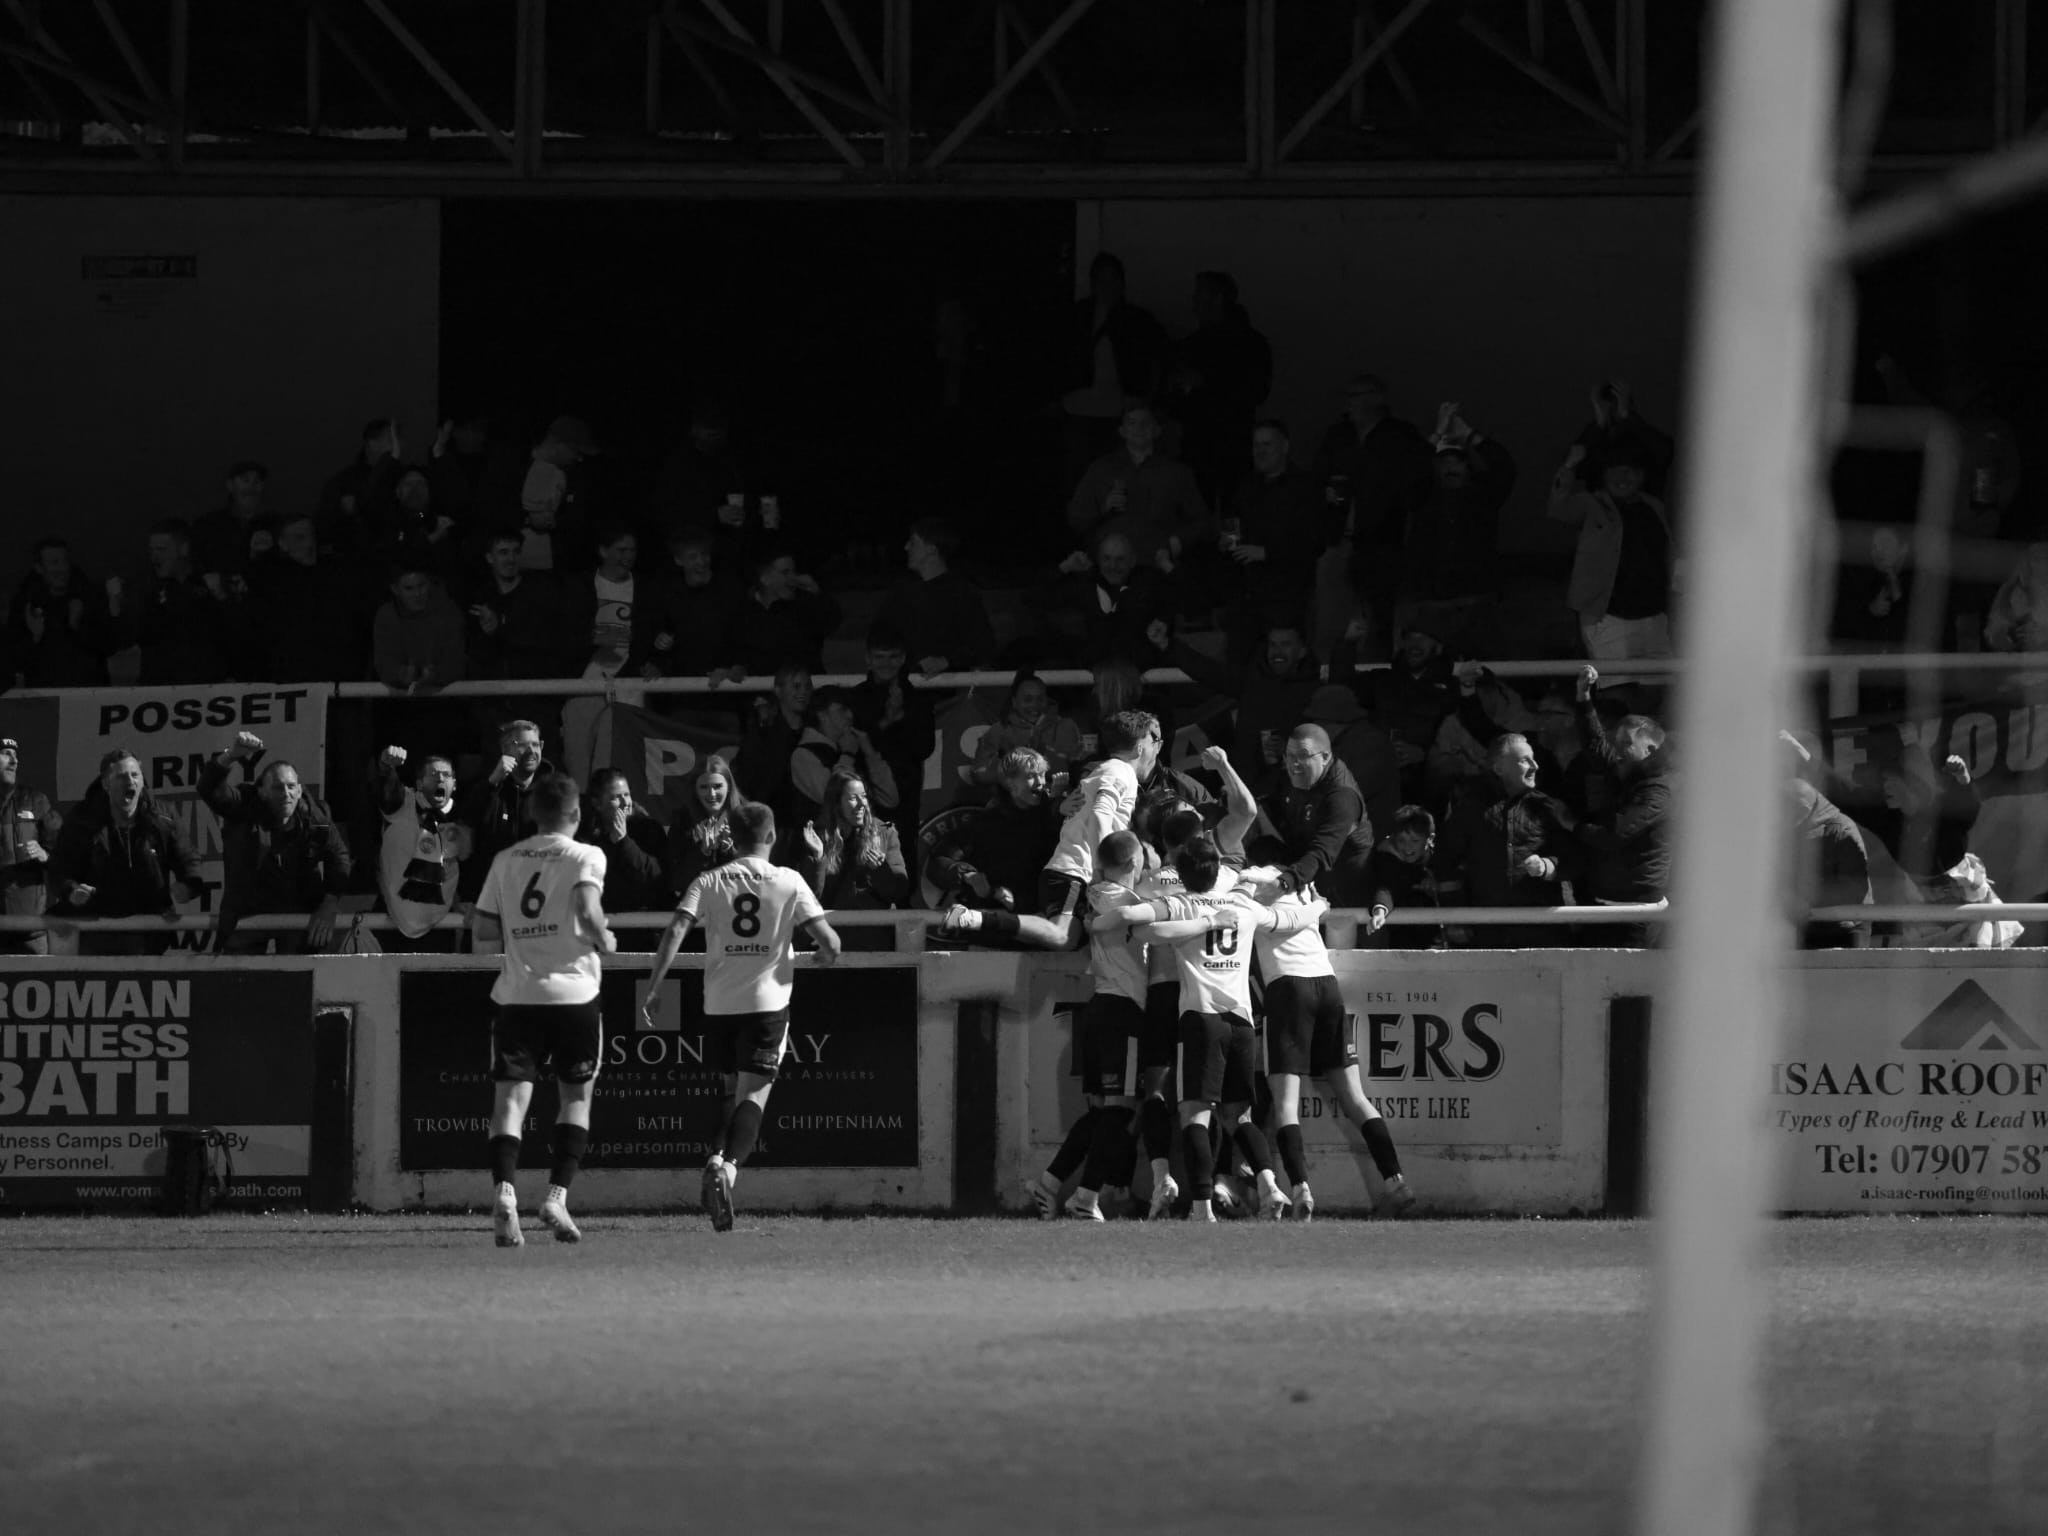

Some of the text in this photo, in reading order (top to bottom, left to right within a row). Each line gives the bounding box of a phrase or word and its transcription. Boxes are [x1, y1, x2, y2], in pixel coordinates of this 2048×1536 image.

[99, 689, 307, 736] POSSET
[152, 748, 266, 789] RMY
[1160, 876, 1184, 885] mac
[521, 871, 546, 919] 6
[732, 893, 760, 938] 8
[511, 923, 559, 936] carite
[1206, 926, 1239, 956] 10
[725, 943, 770, 953] carite
[1203, 960, 1241, 969] carite
[0, 979, 191, 1019] OMAN
[1407, 992, 1438, 1002] 1904
[0, 1023, 190, 1058] ITNESS
[1770, 1062, 2048, 1096] ISAAC ROOF
[594, 1087, 718, 1098] Originated 1841
[1367, 1096, 1420, 1119] ASTE
[1427, 1096, 1471, 1119] LIKE
[637, 1116, 684, 1131] BATH
[778, 1114, 905, 1129] CHIPPENHAM
[1777, 1110, 1832, 1133] Types
[1838, 1110, 1862, 1133] of
[1864, 1110, 1944, 1133] Roofing
[1951, 1110, 1968, 1128] &
[1975, 1110, 2026, 1128] Lead
[57, 1133, 123, 1152] Camps
[225, 1132, 249, 1151] By
[14, 1154, 115, 1171] Personnel.
[1815, 1144, 1878, 1174] Tel:
[1891, 1144, 1990, 1174] 07907
